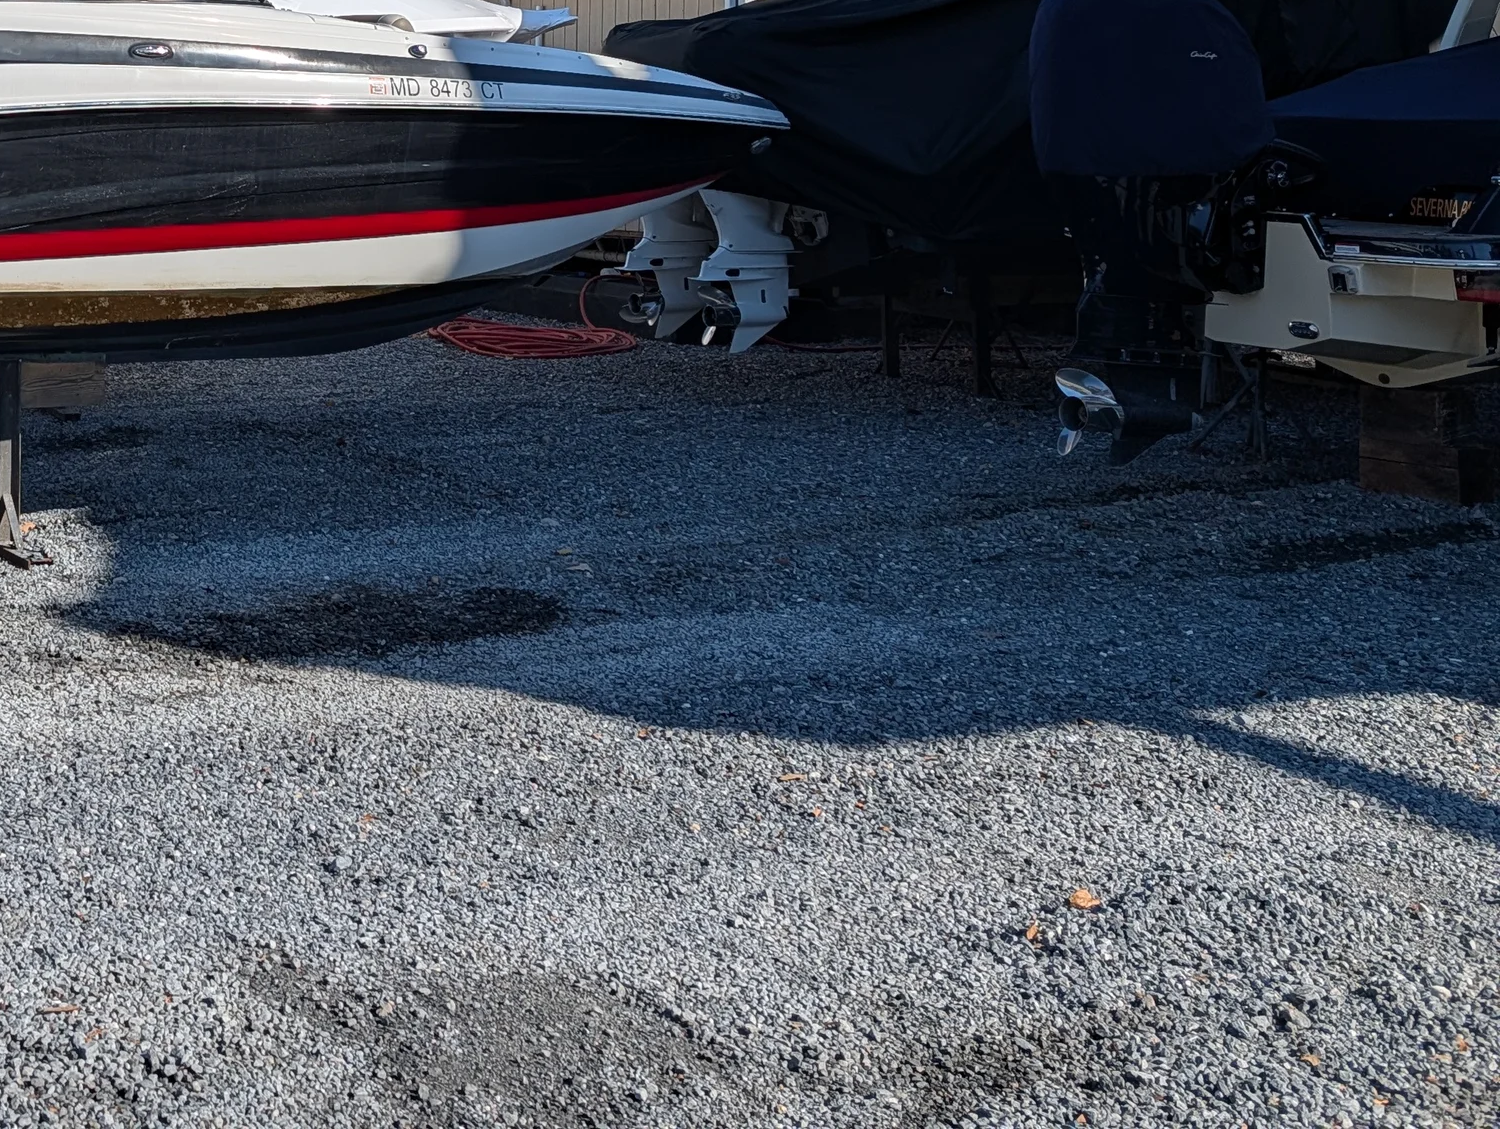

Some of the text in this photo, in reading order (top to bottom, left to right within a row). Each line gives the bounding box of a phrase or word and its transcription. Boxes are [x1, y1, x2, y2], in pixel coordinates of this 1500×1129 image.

[390, 77, 421, 97] MD
[430, 78, 473, 98] 8473
[481, 81, 504, 100] CT
[1409, 197, 1459, 219] SEVERNA
